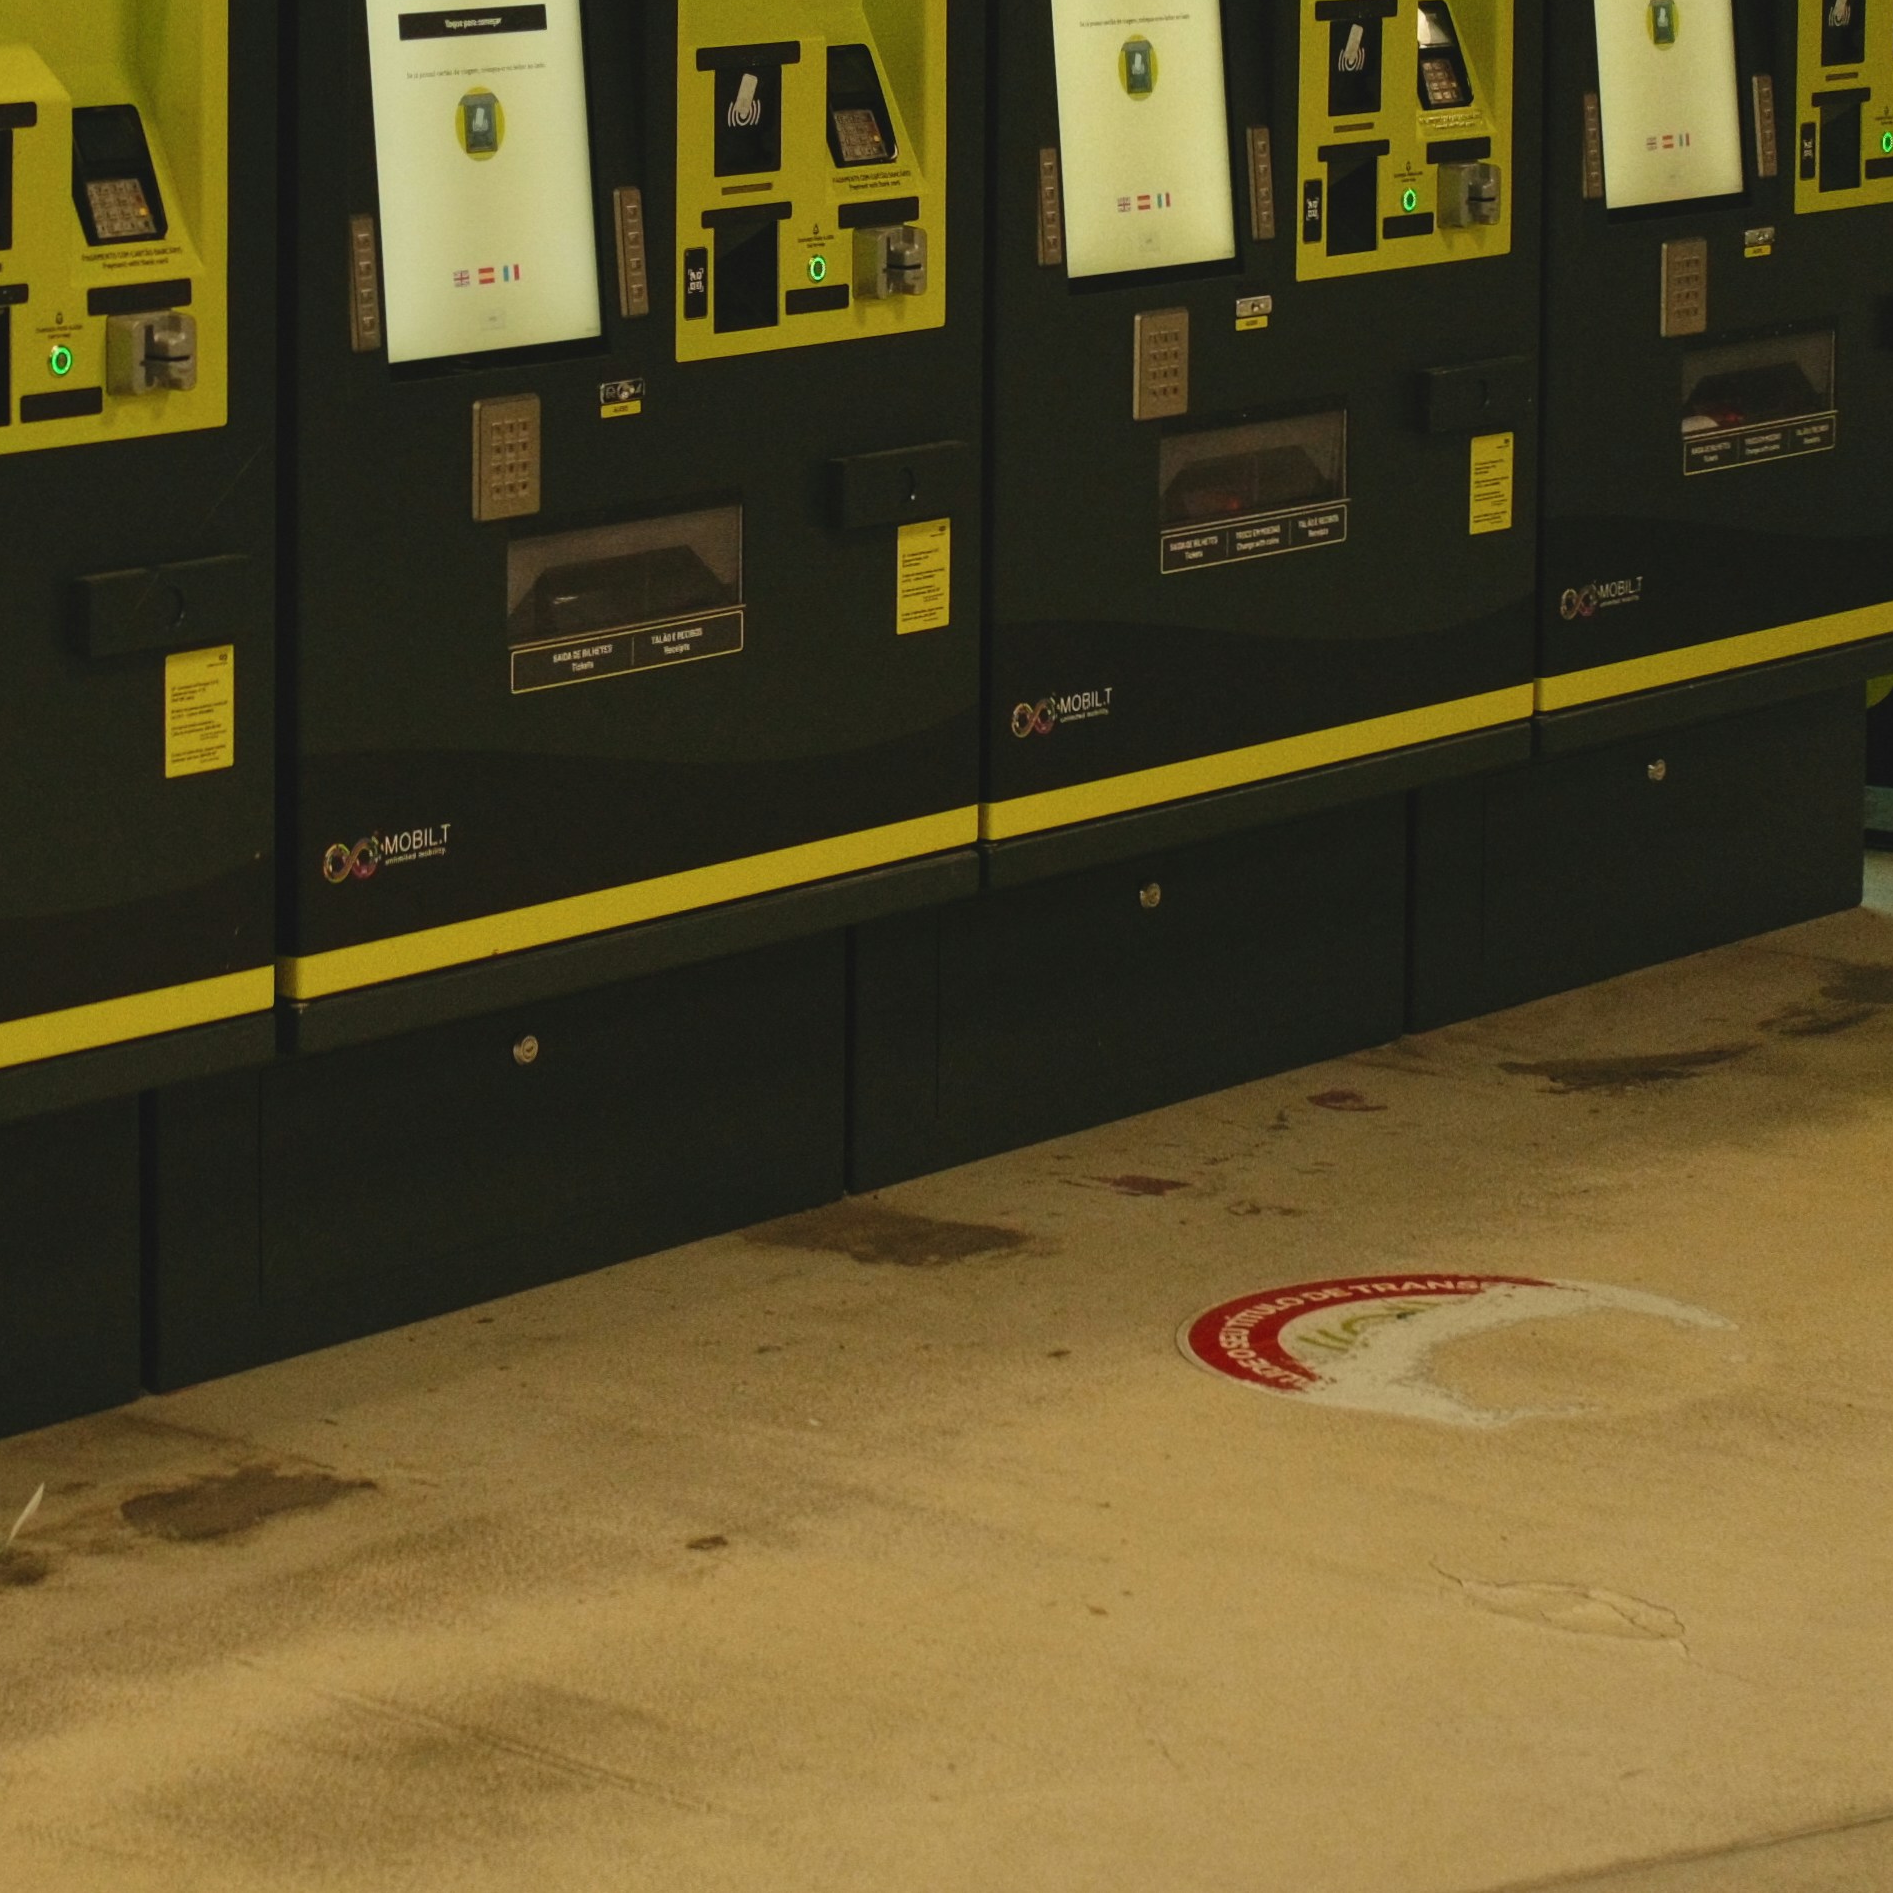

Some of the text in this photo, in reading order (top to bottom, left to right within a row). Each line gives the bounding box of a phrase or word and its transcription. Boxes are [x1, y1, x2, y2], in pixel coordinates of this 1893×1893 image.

[384, 823, 451, 855] MOBIL.T
[1227, 1349, 1257, 1360] O
[1300, 1286, 1354, 1303] DE
